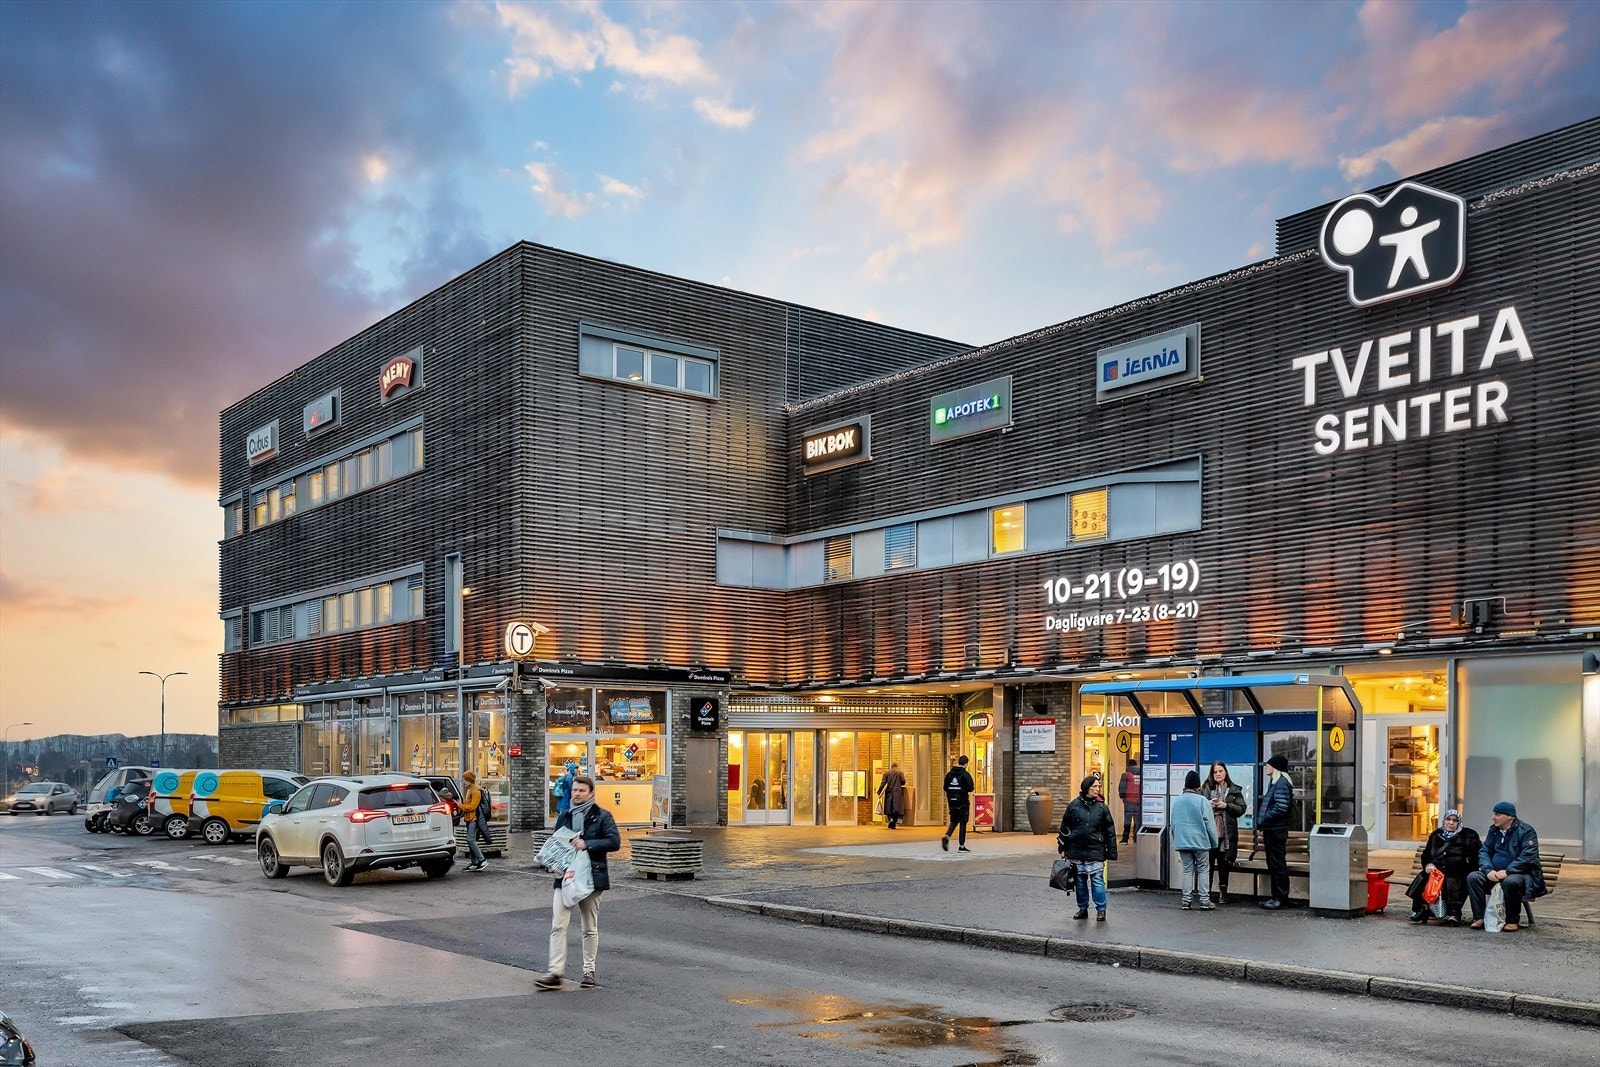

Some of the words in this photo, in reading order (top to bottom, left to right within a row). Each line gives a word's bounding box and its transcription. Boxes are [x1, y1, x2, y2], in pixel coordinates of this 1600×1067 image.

[1291, 306, 1536, 407] TVEITA
[382, 362, 410, 389] MENY
[1313, 380, 1509, 455] SENTER
[249, 434, 268, 454] Cubus
[1046, 612, 1113, 632] Dagligvare
[516, 632, 528, 650] T
[1207, 717, 1234, 728] Tveita
[1237, 717, 1244, 727] T
[1120, 735, 1128, 748] A
[1334, 732, 1340, 746] A
